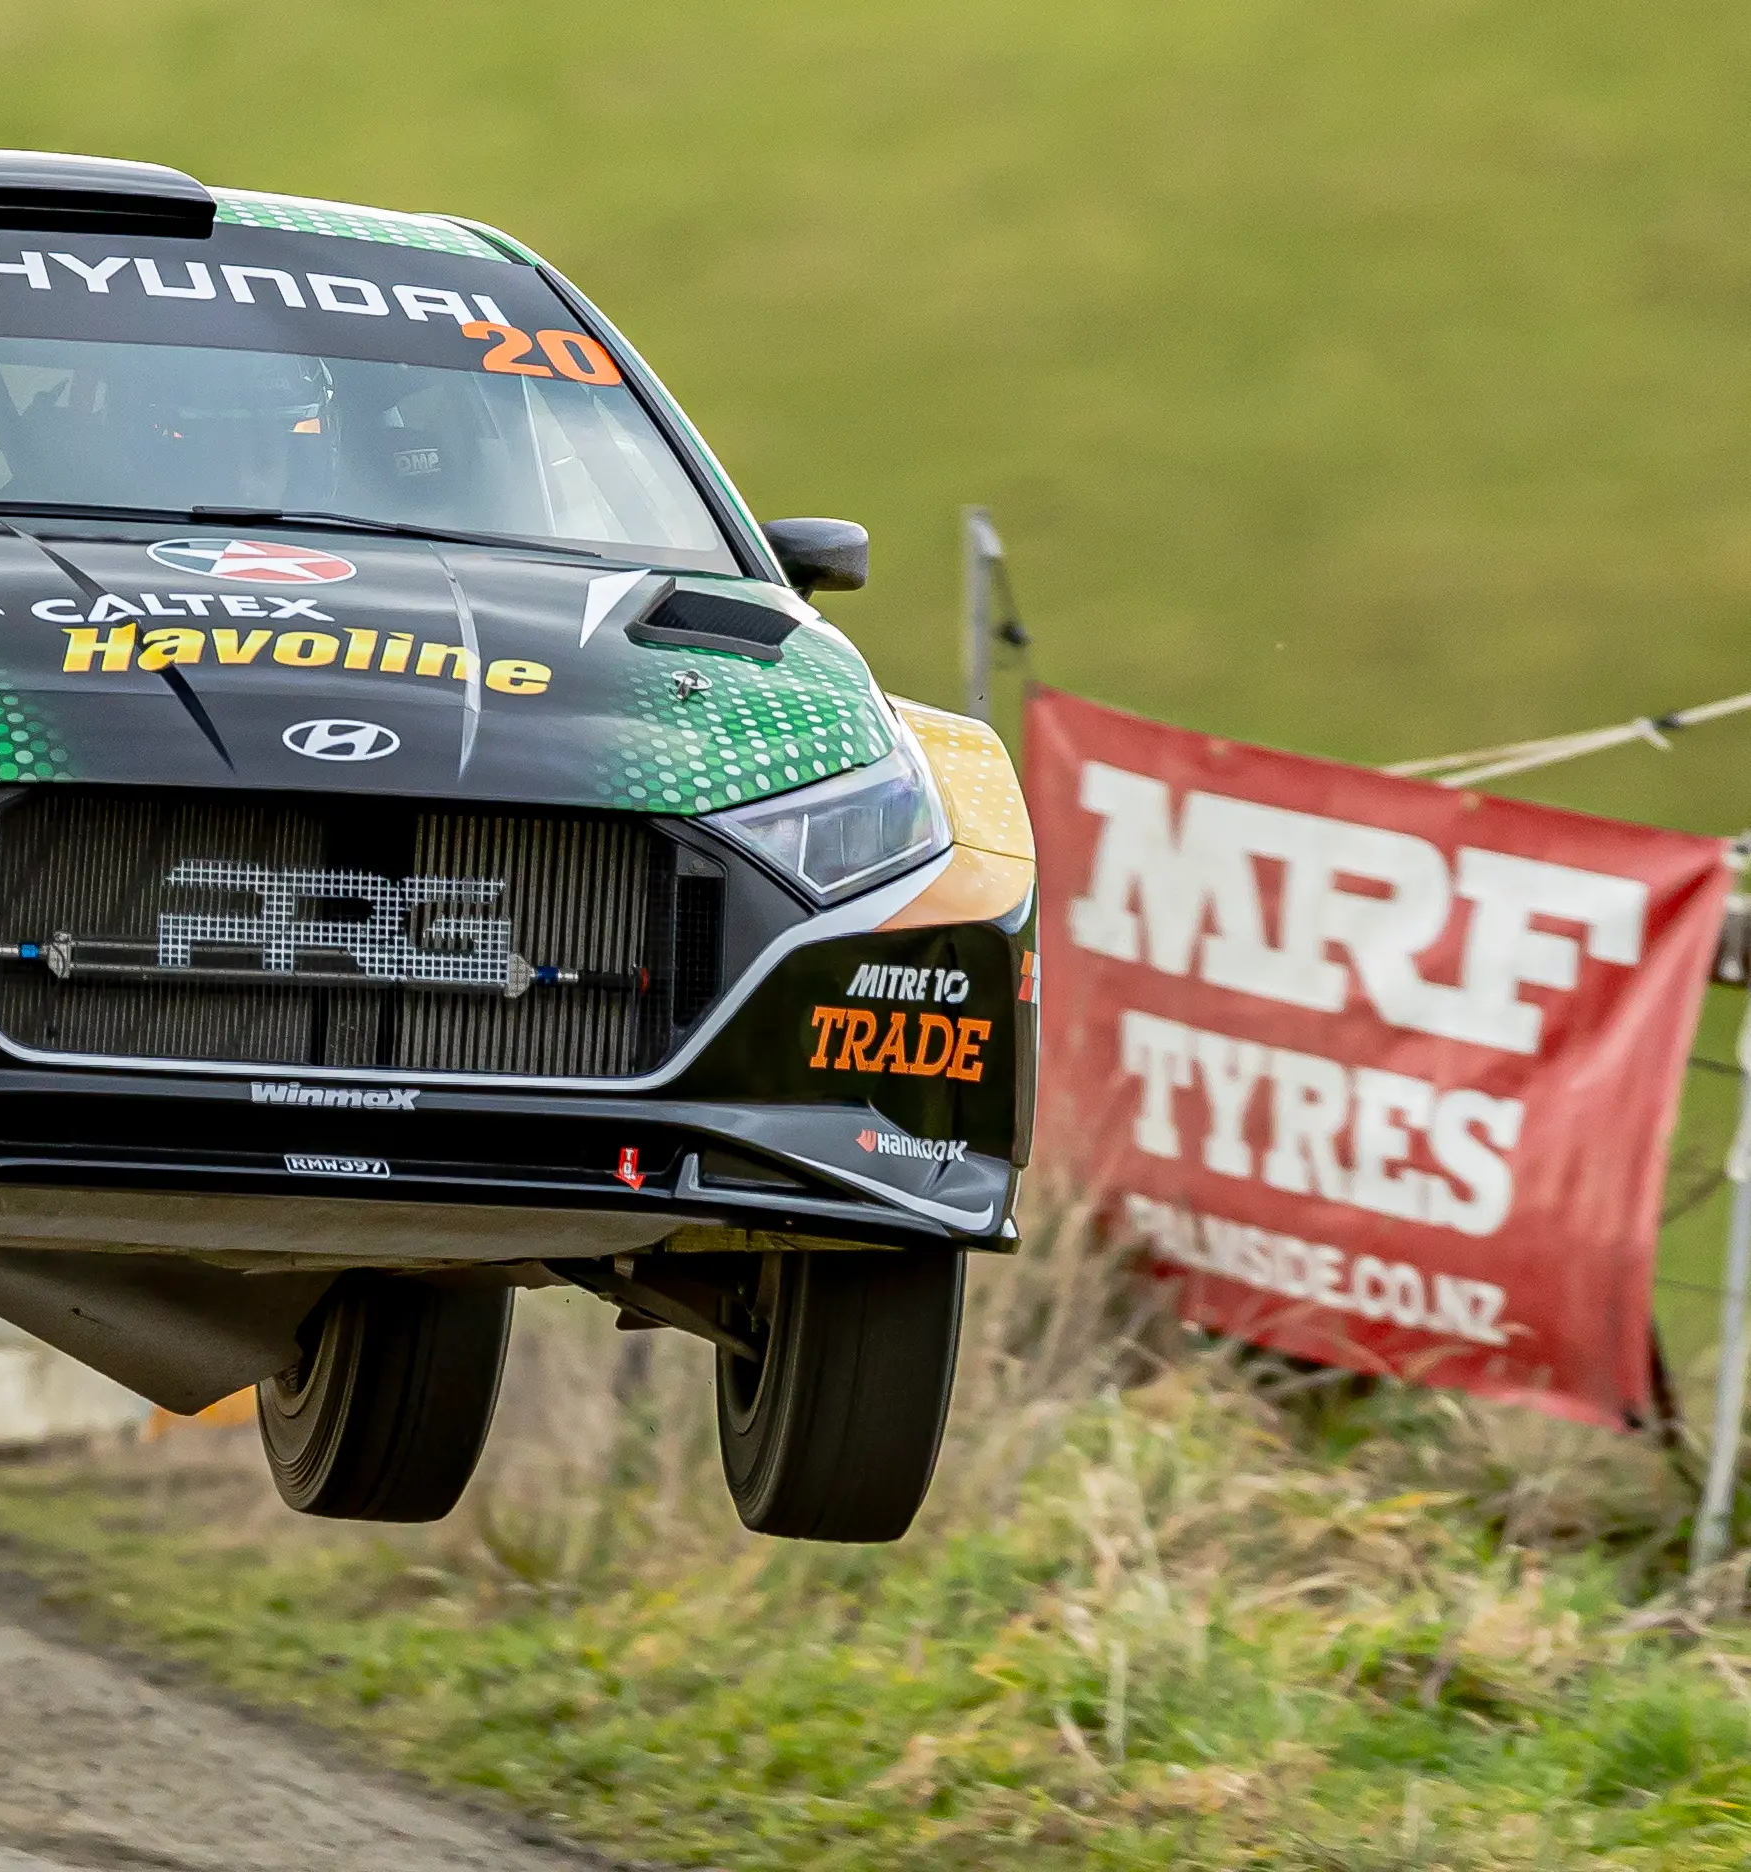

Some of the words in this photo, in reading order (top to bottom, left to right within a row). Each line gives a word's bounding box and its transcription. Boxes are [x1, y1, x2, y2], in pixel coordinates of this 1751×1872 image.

[461, 320, 622, 386] 20
[30, 593, 335, 623] CALTEX
[62, 623, 552, 695] Havoline
[1068, 761, 1649, 1054] MRF
[846, 964, 932, 1001] MITRE
[934, 968, 970, 1005] 10
[809, 1005, 992, 1083] TRADE
[1119, 1010, 1524, 1237] TYRES
